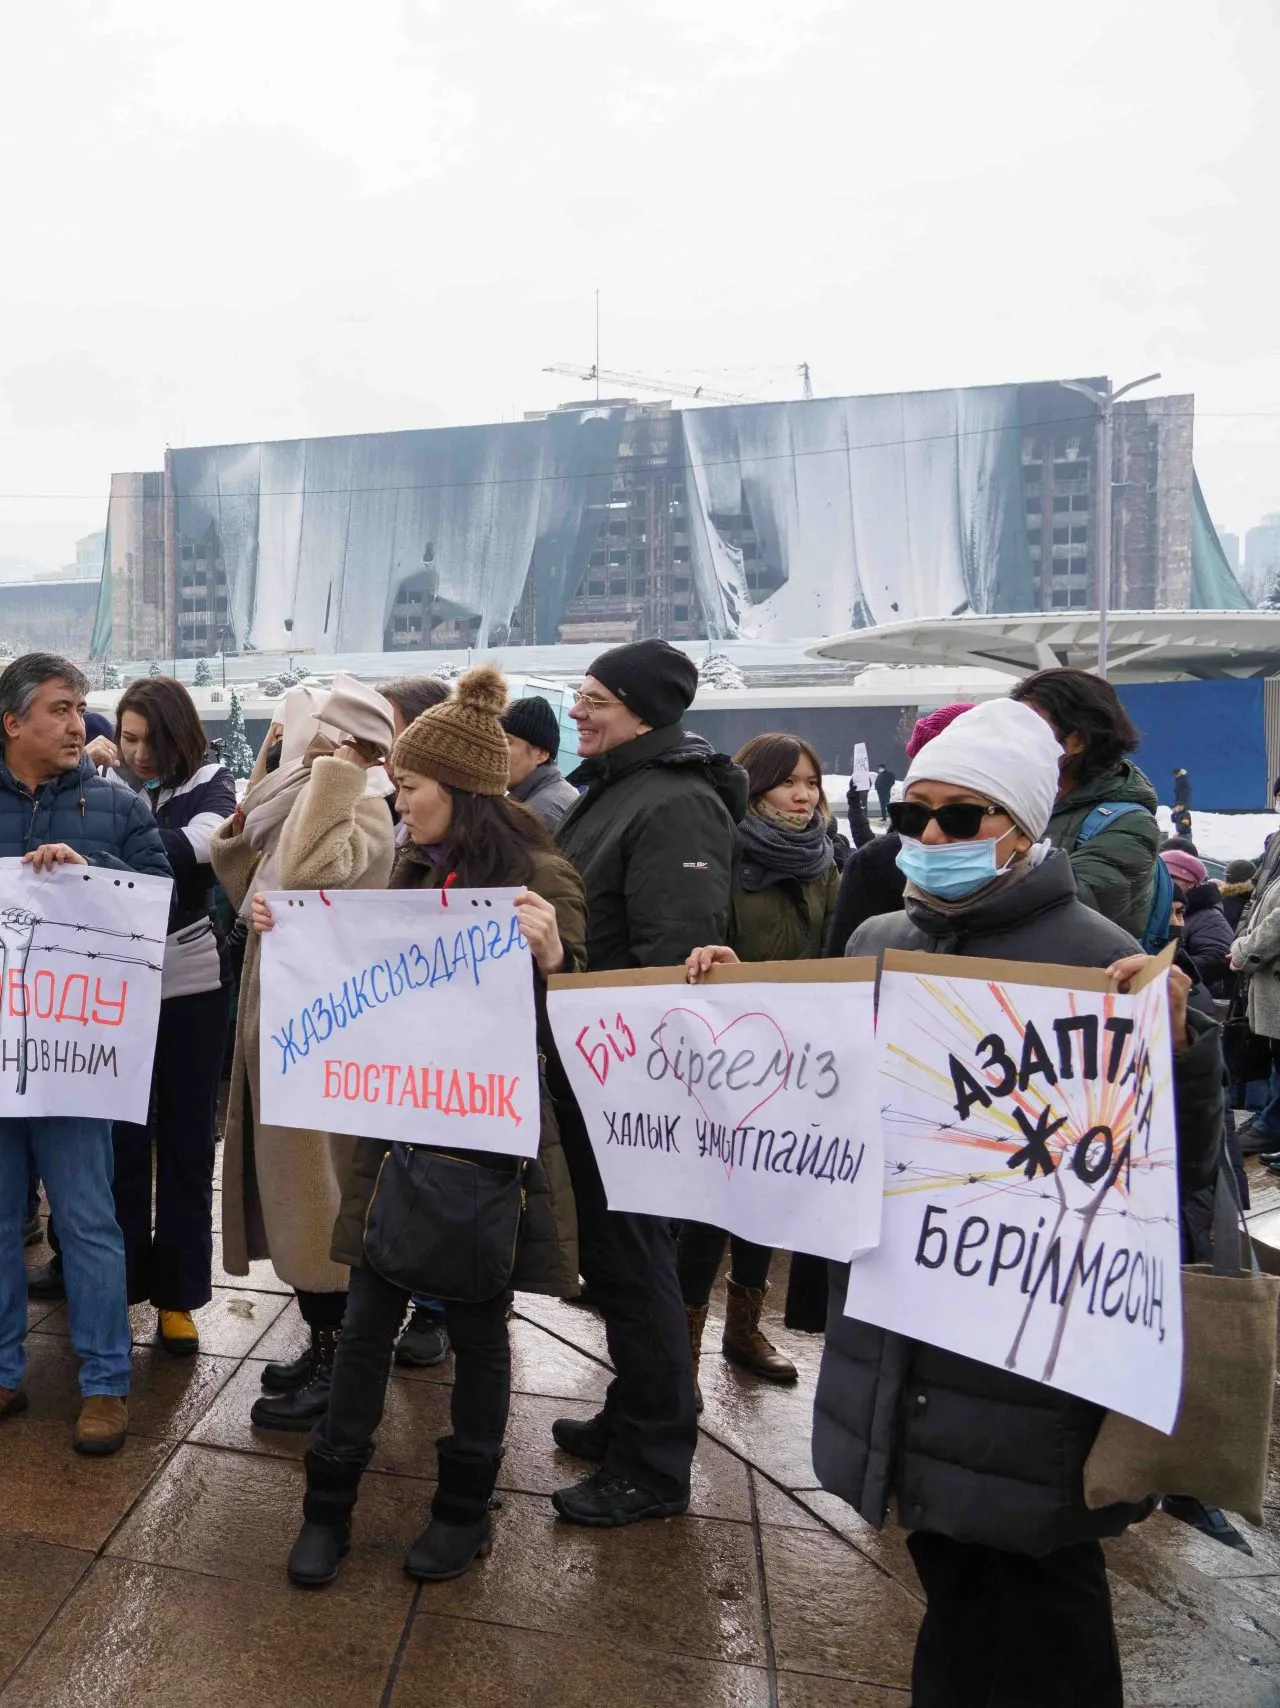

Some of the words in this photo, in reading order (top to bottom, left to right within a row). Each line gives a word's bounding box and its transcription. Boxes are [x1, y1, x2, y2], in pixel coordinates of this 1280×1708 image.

[322, 1060, 523, 1127] БОСТАНДЫҚ
[575, 1012, 637, 1086] Біз
[646, 1022, 840, 1099] біргеміз
[1006, 1104, 1132, 1195] ЖОЛ
